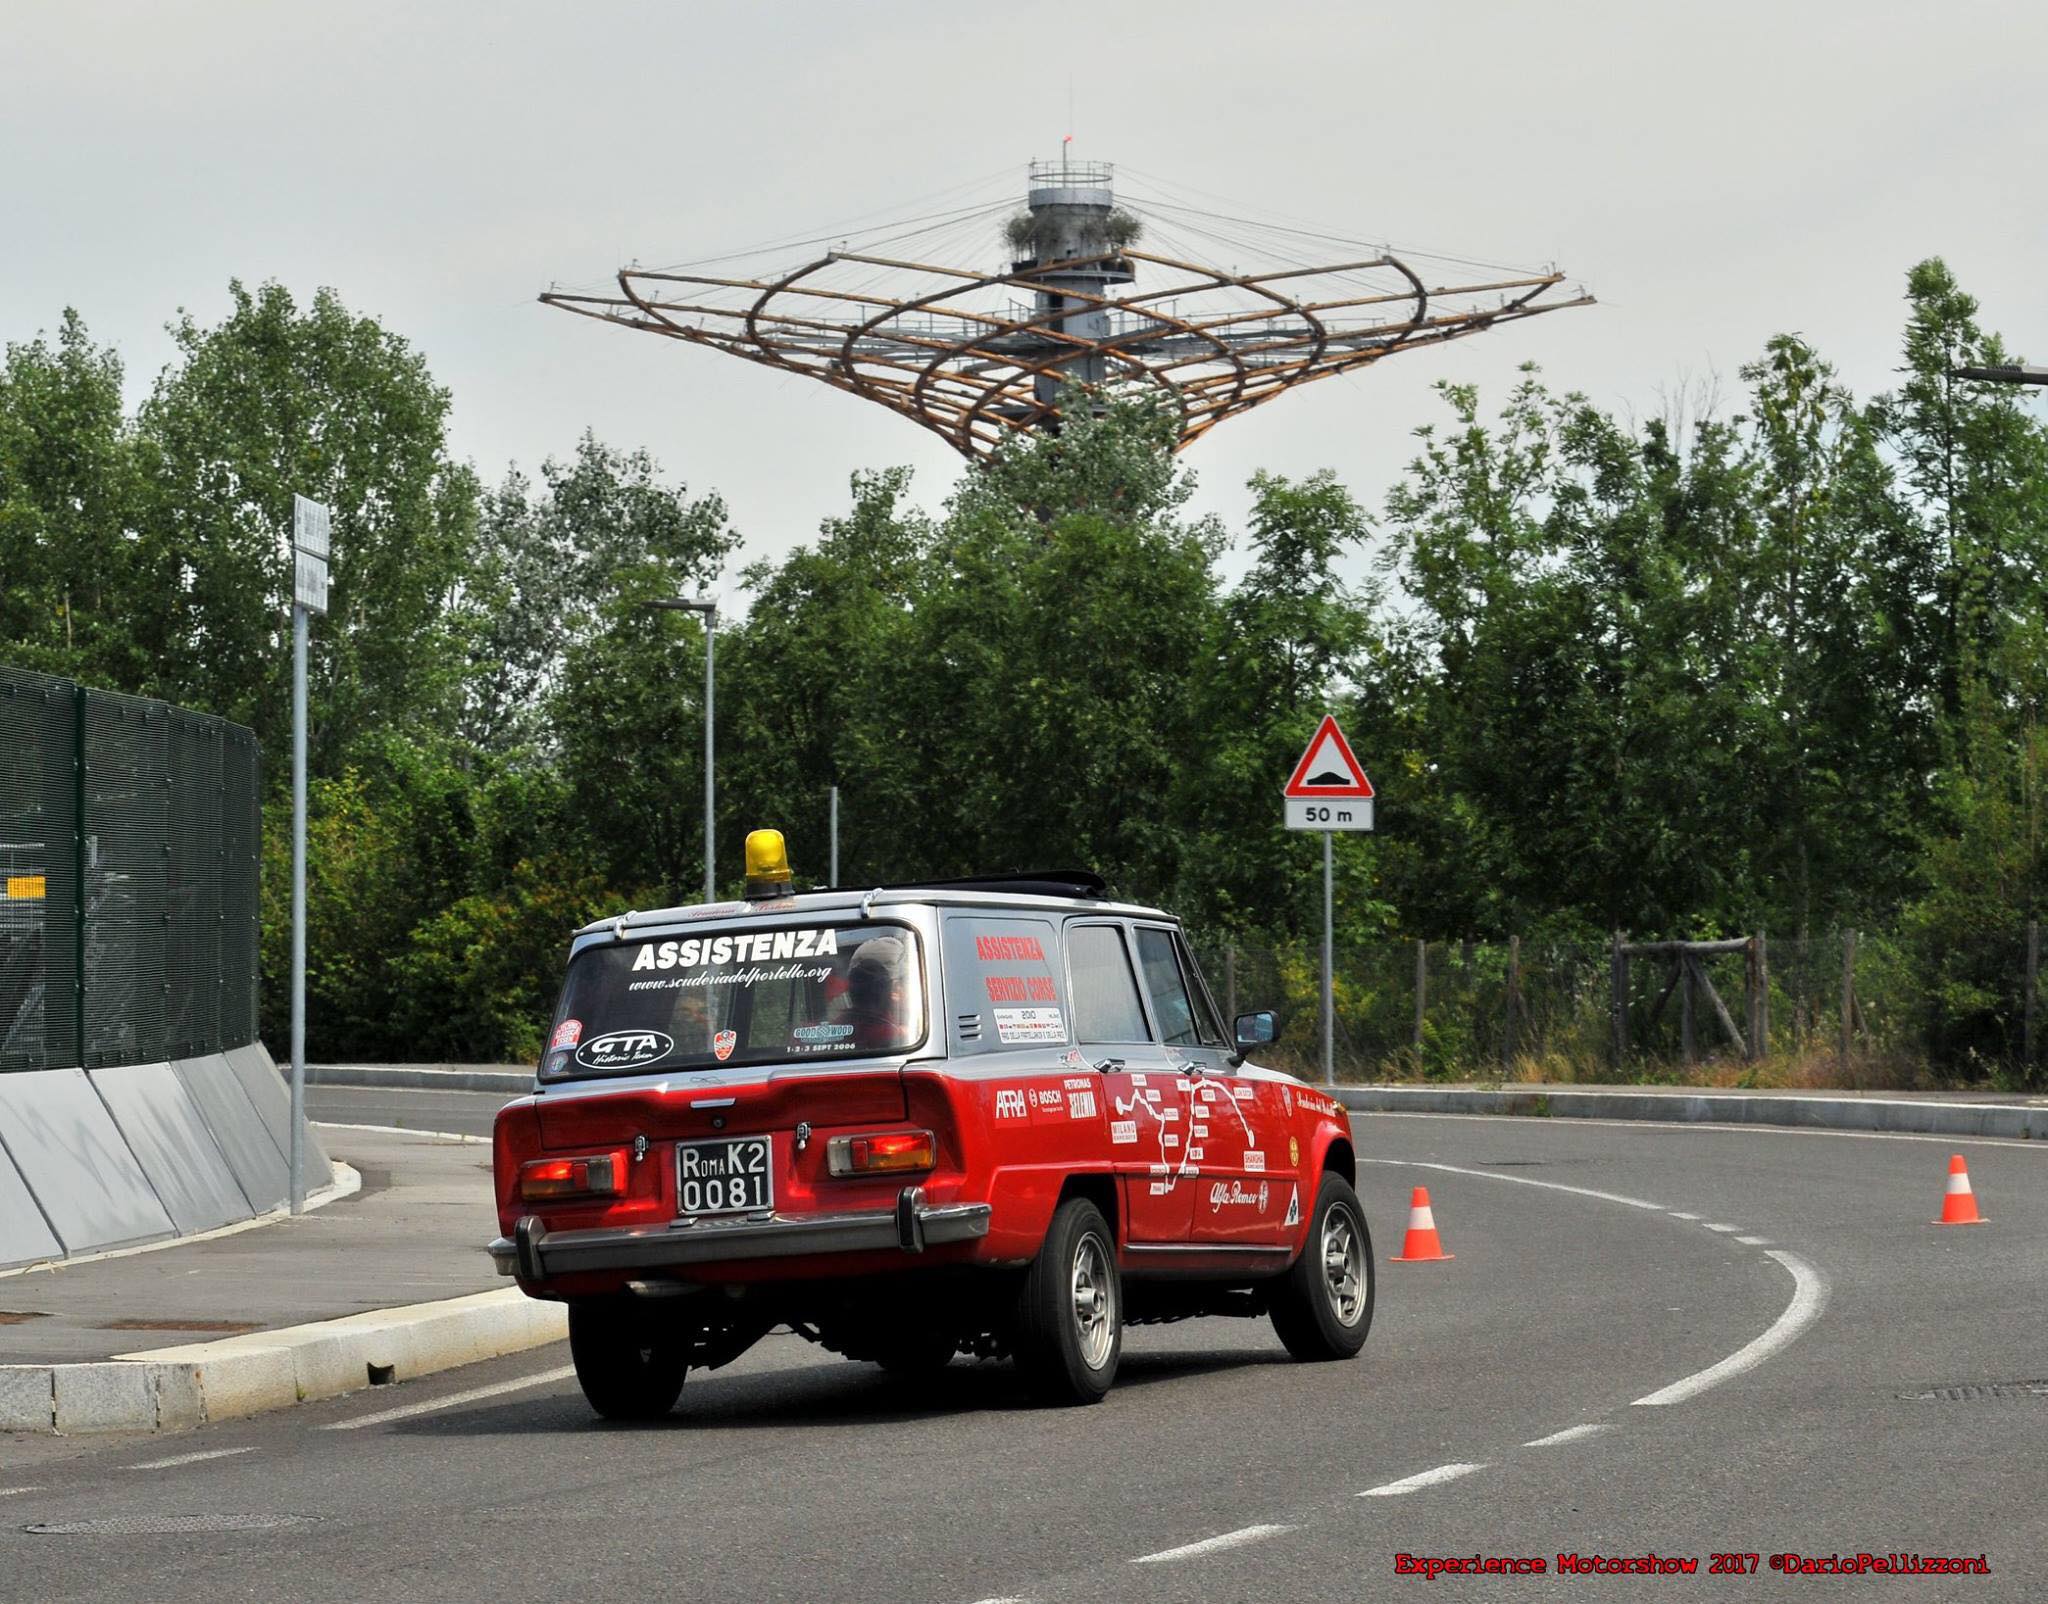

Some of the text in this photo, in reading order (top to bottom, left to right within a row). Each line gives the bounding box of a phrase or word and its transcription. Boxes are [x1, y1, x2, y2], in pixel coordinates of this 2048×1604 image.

[1305, 807, 1353, 822] 50 m
[631, 928, 838, 972] ASSISTENZA
[976, 936, 1045, 960] ASSISTENZA
[628, 963, 833, 992] www.scuderiadelportello.org
[591, 1034, 658, 1054] GTA
[812, 1044, 832, 1052] SEPT
[1063, 1077, 1092, 1090] PETRONAS
[995, 1088, 1027, 1119] AFRA
[1038, 1089, 1063, 1105] BOSCH
[1112, 1122, 1136, 1134] MILANO
[683, 1175, 762, 1211] 0081
